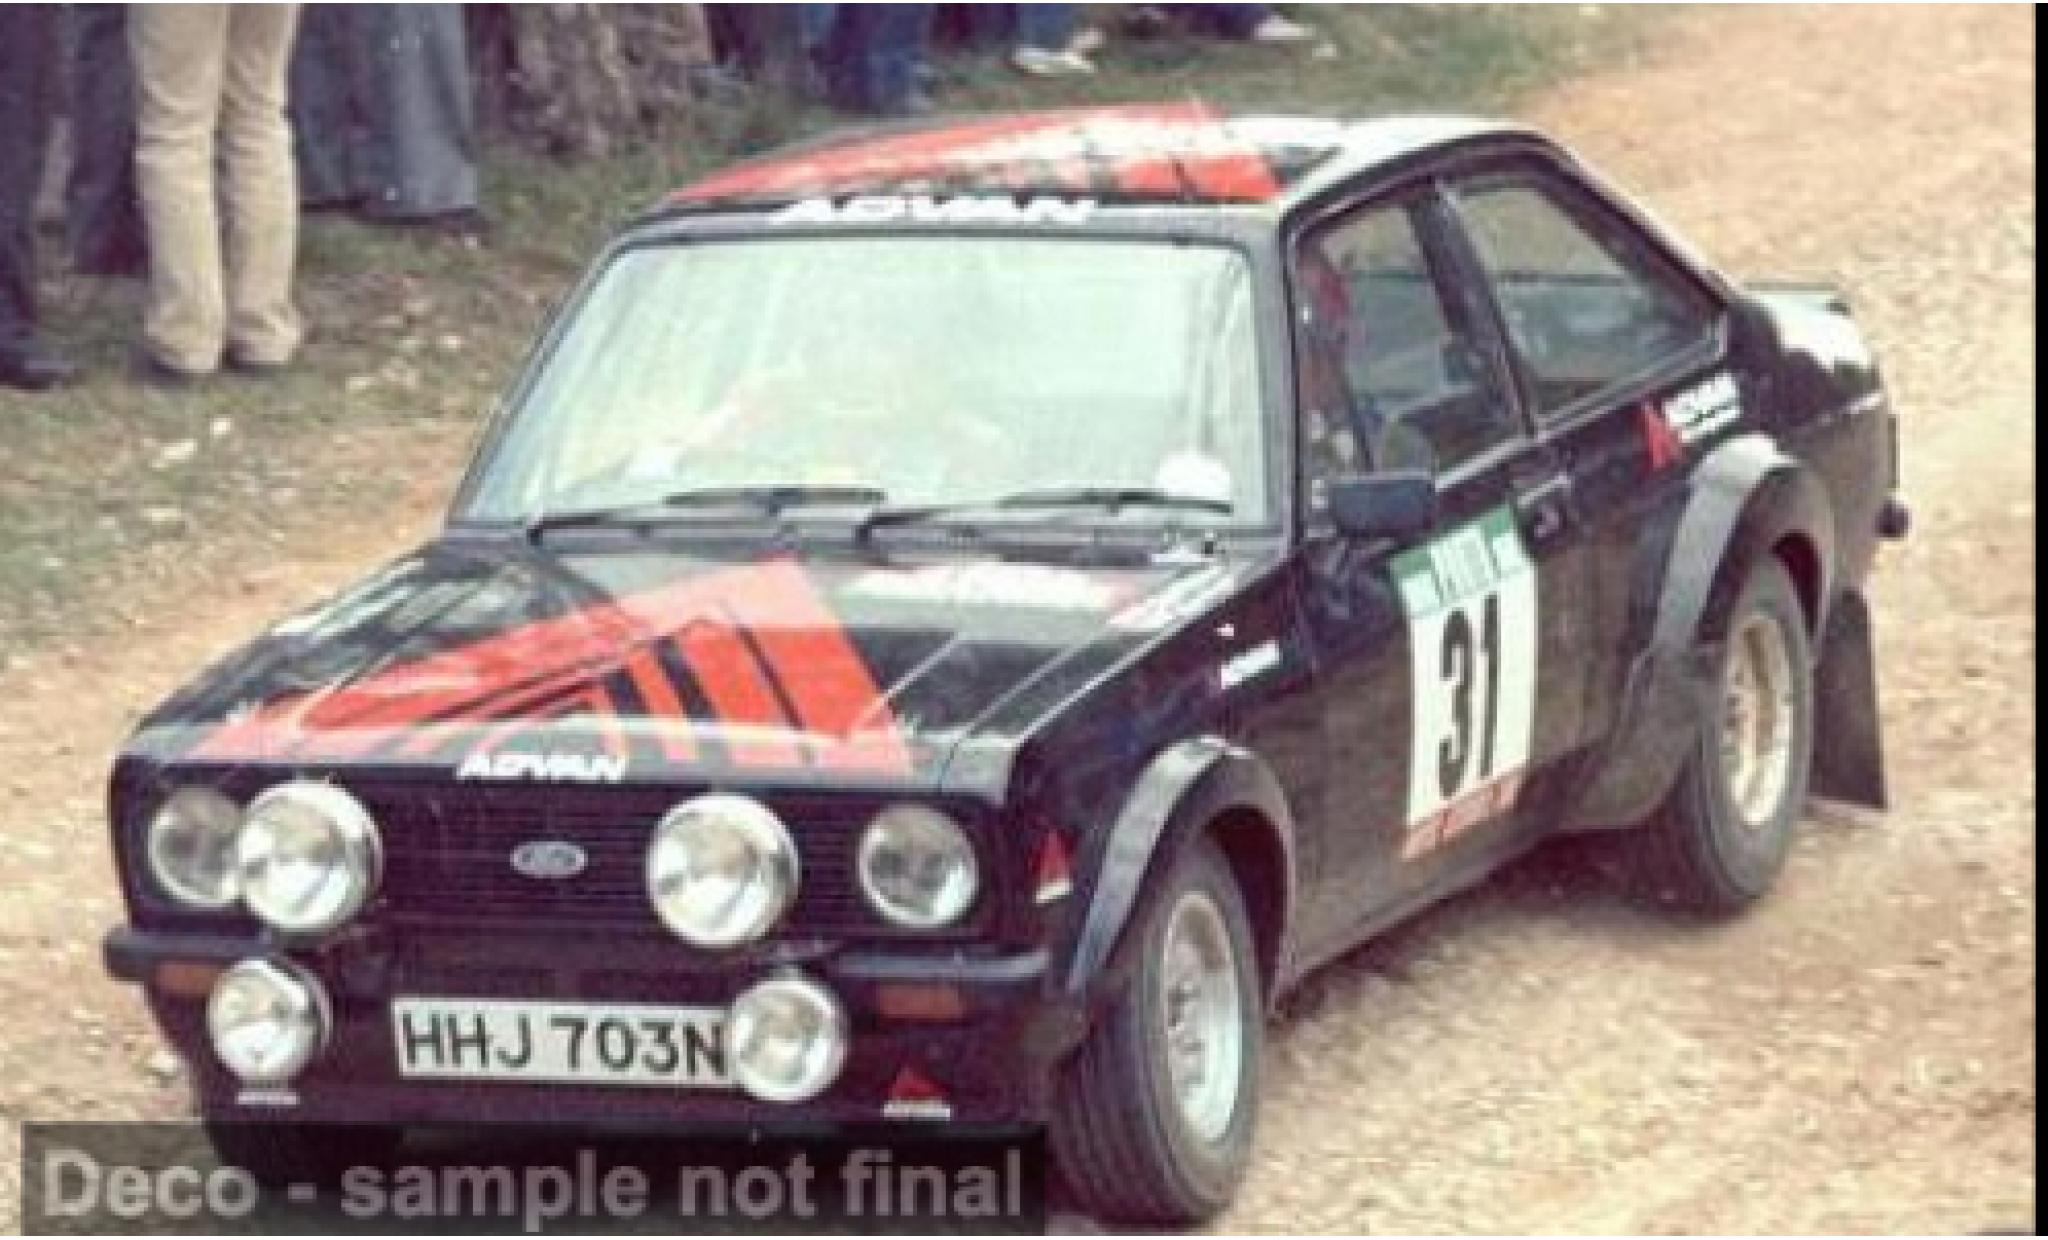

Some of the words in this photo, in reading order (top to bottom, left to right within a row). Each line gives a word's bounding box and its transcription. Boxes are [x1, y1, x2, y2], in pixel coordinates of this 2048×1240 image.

[769, 195, 1092, 226] ADVAN
[1438, 594, 1499, 798] 31
[457, 753, 629, 784] ADVAN
[402, 1009, 533, 1070] HHJ
[550, 1016, 727, 1077] 703N
